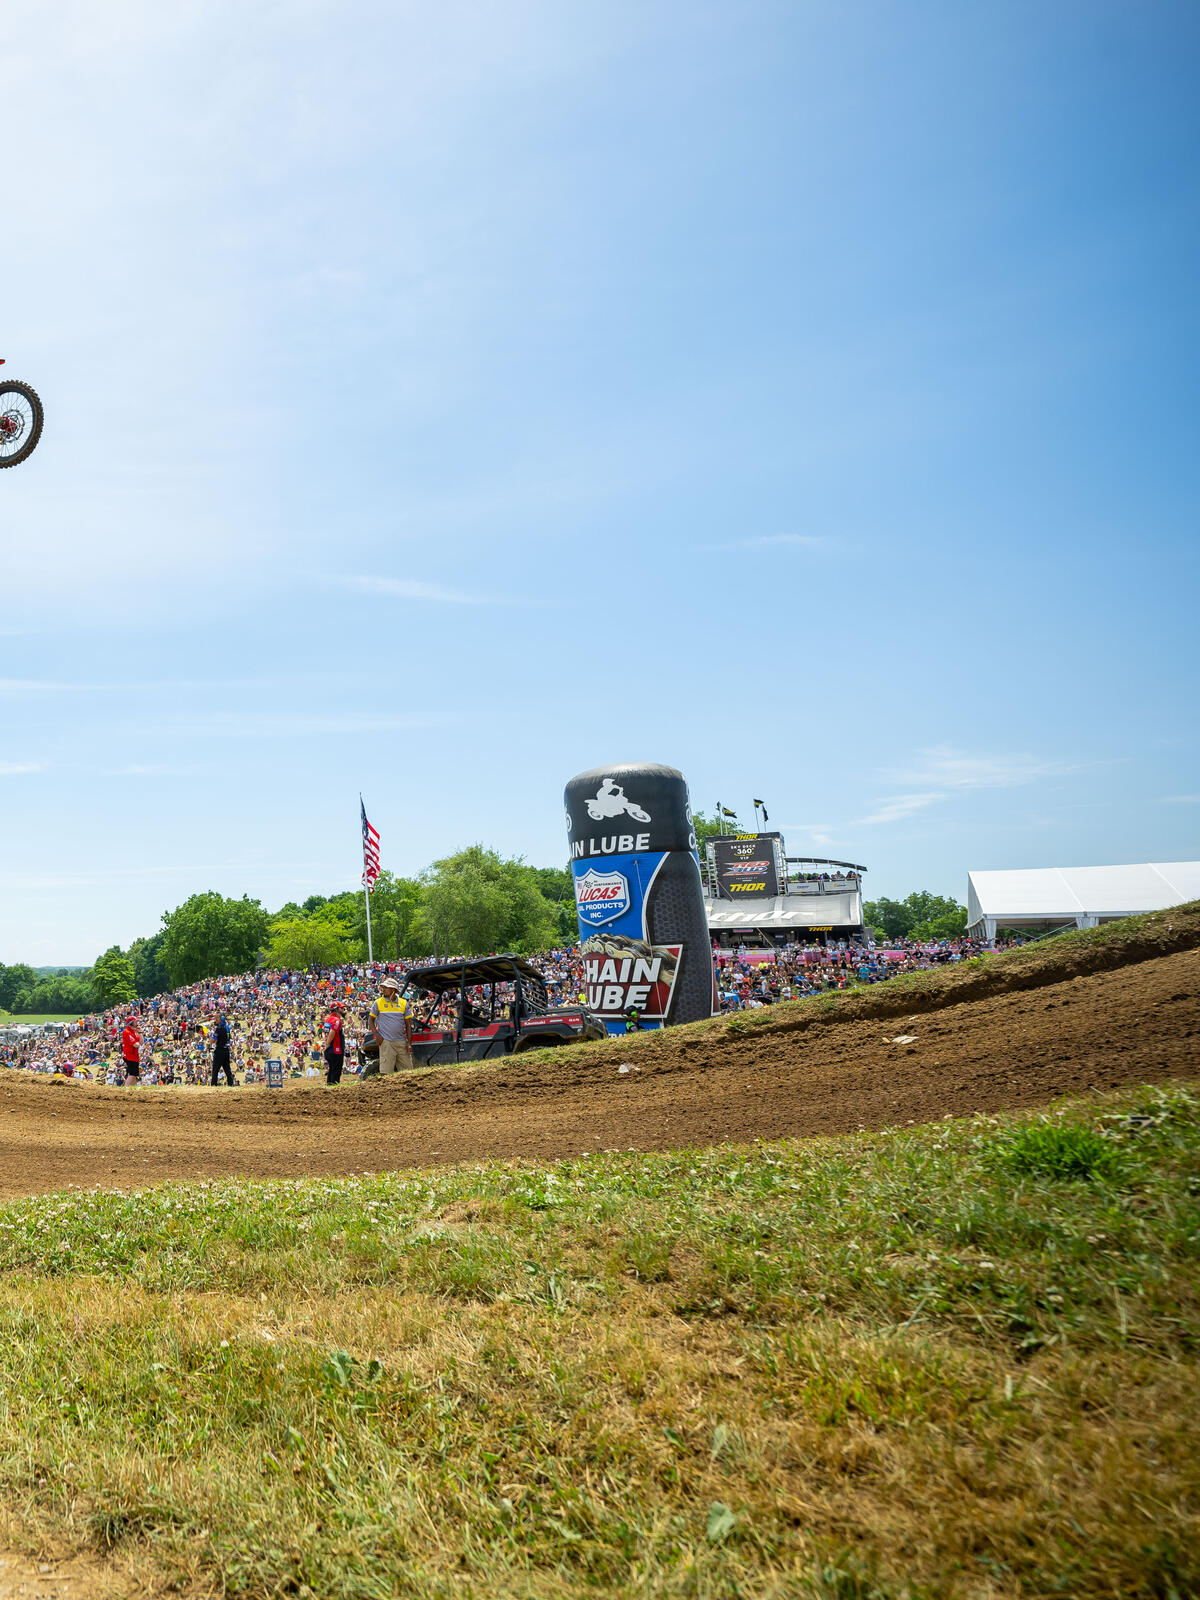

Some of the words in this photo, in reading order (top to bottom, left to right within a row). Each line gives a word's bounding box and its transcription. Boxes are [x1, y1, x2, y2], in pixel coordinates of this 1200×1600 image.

[589, 833, 651, 855] LUBE
[578, 886, 622, 902] LUCAS
[729, 882, 767, 892] THOR
[585, 902, 624, 911] PRODUCTS
[585, 958, 661, 983] HAIN
[588, 985, 651, 1010] UBE
